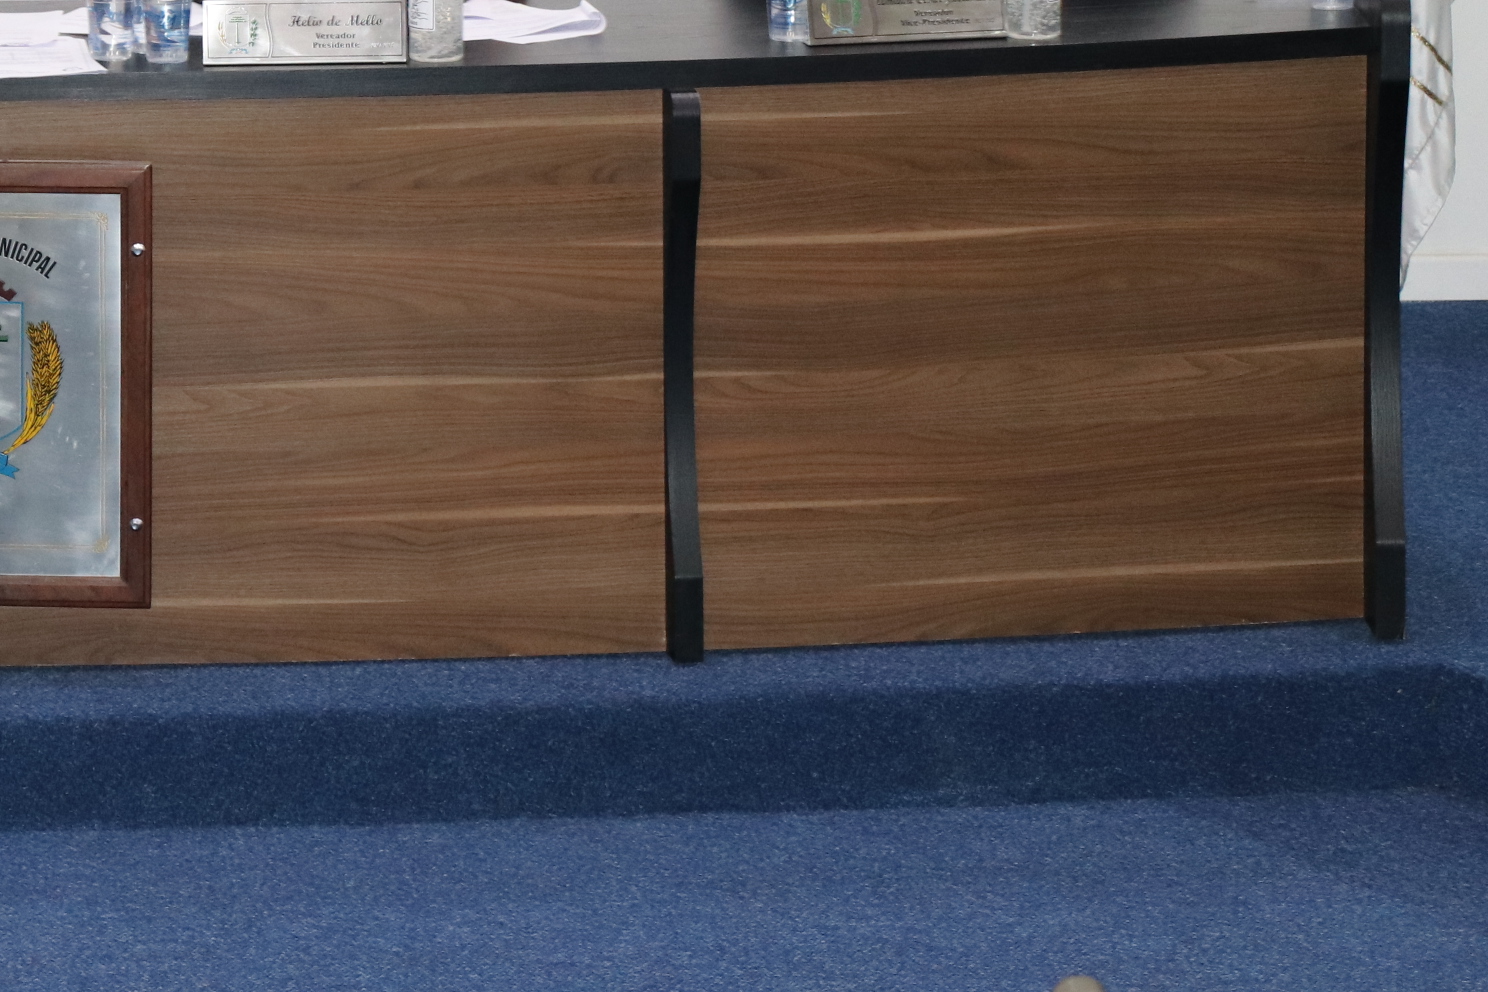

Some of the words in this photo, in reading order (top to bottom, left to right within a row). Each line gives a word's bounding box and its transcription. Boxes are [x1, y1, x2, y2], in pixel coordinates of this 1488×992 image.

[326, 15, 341, 26] de
[345, 14, 384, 27] Mello
[315, 32, 356, 40] Vereador
